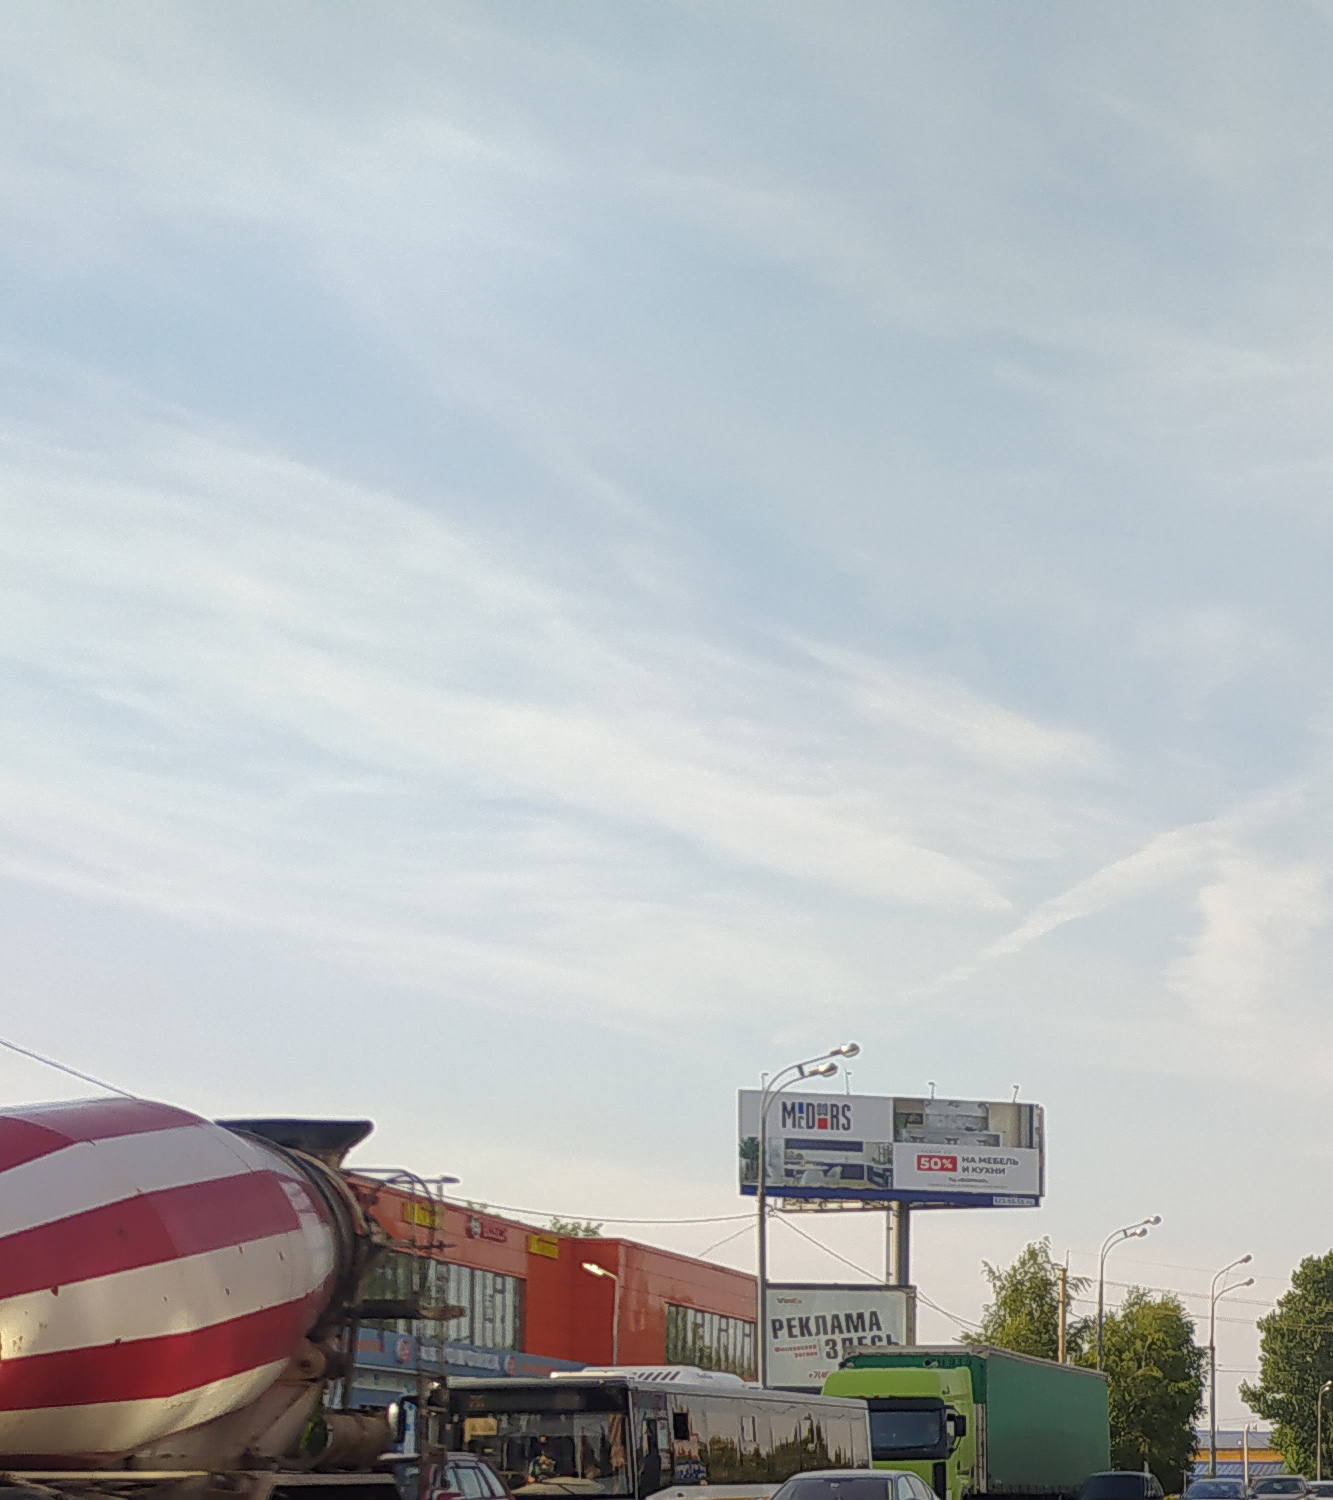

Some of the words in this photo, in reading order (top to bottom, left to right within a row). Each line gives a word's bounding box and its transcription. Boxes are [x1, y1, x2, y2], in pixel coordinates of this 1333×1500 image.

[918, 1156, 954, 1170] 50%
[961, 1156, 977, 1164] НА
[978, 1156, 1019, 1166] МЕБЕЛЬ
[961, 1166, 970, 1174] И
[971, 1166, 1006, 1175] КУХНИ
[770, 1310, 883, 1340] РЕКЛАМА
